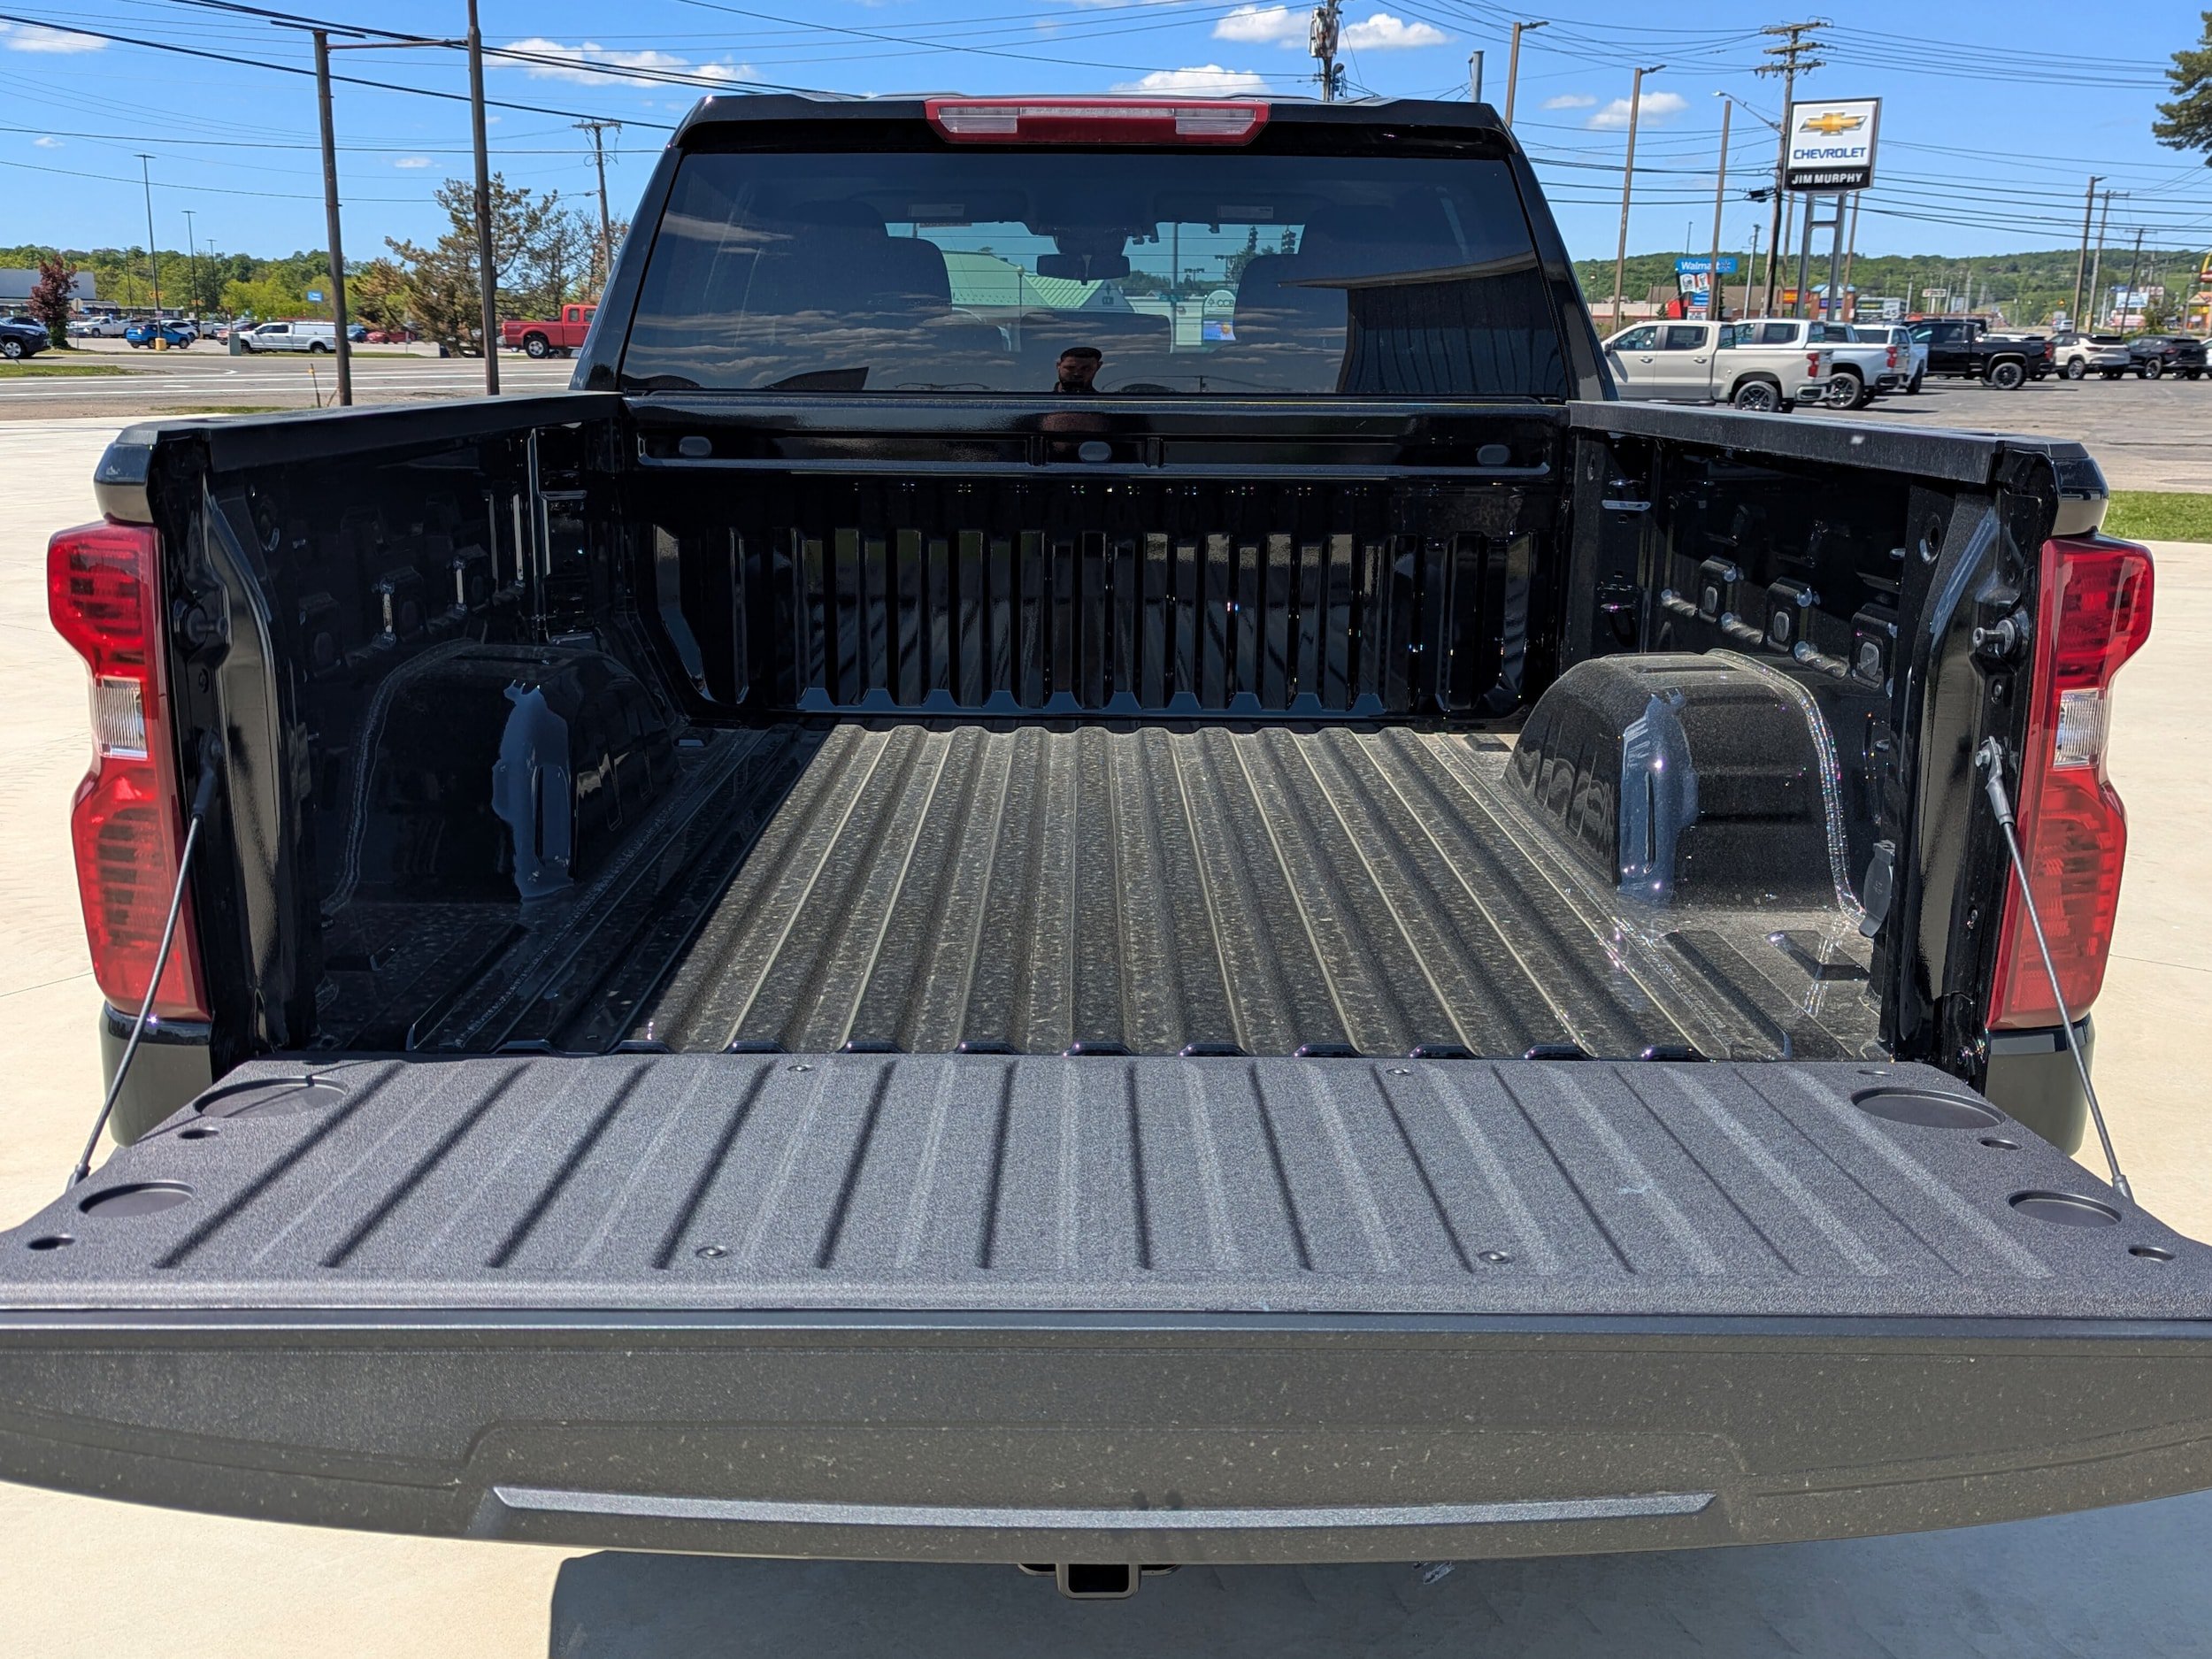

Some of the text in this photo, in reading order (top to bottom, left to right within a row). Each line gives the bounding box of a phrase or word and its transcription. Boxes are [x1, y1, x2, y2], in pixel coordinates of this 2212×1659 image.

[1793, 147, 1867, 159] CHEVROLET
[1791, 173, 1863, 185] JIM MURPHY
[1681, 261, 1720, 271] Walmat
